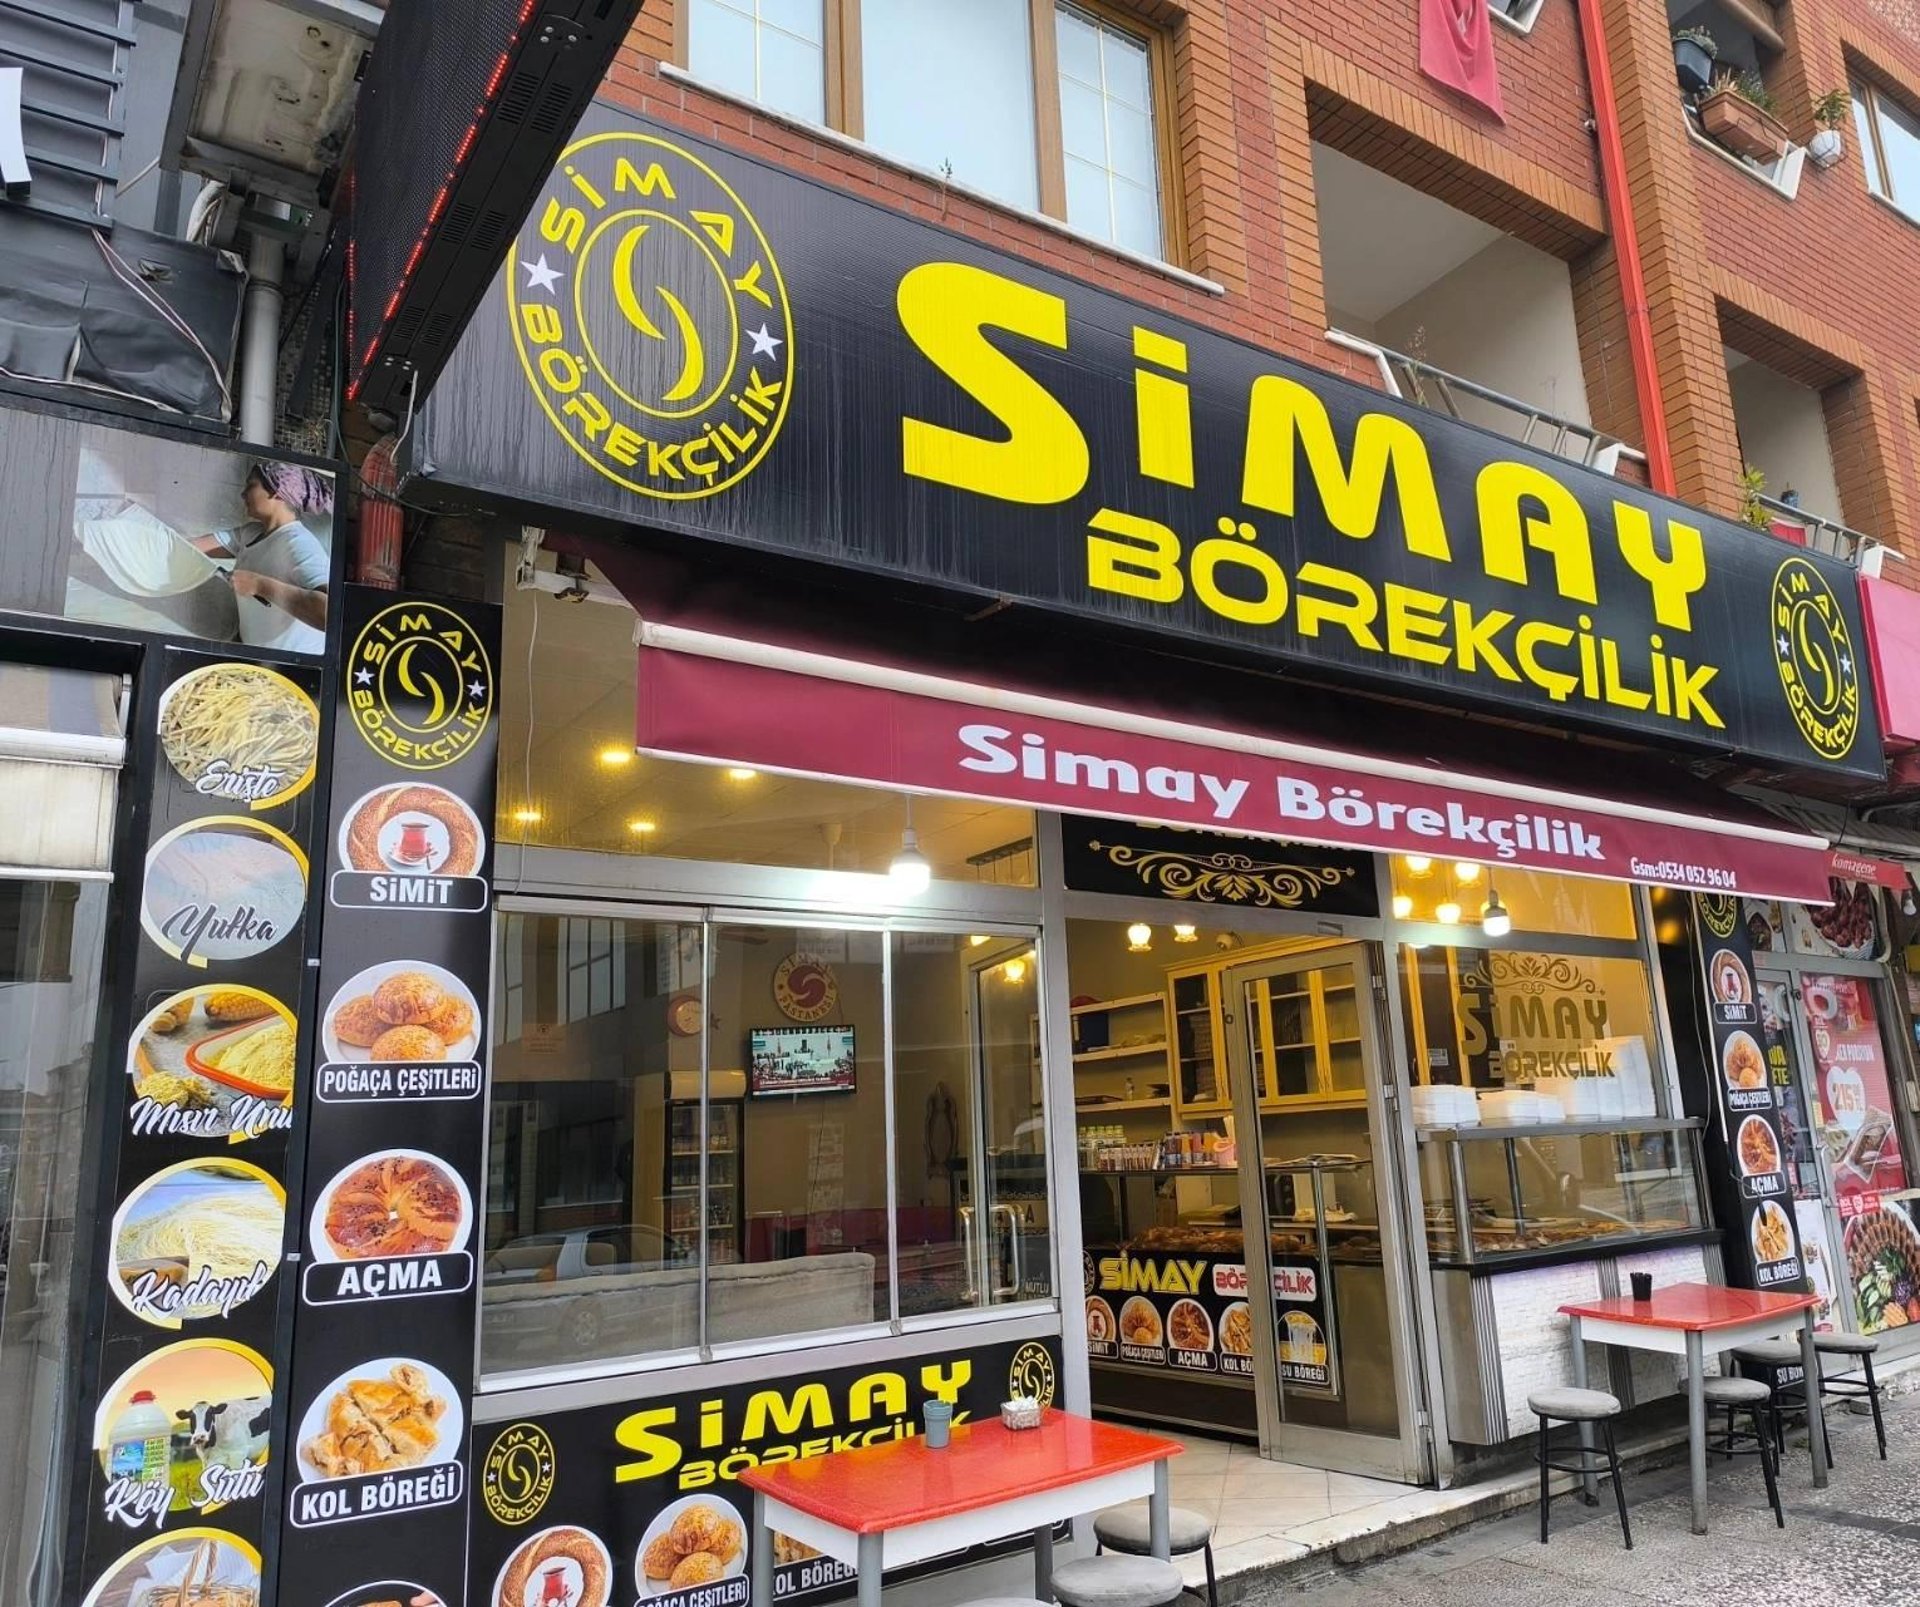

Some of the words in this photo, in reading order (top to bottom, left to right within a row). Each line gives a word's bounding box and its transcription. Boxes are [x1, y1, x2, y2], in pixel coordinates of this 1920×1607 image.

[541, 157, 772, 309] SİMAY
[521, 304, 782, 486] BÖREKÇİLİK
[897, 262, 1707, 632] SİMAY
[1087, 508, 1726, 728] BÖREKÇİLİK
[1778, 573, 1846, 644] SİMAY
[363, 613, 482, 673] SİMAY
[353, 690, 486, 760] BÖREKÇİLİK
[1781, 662, 1856, 749] BÖREKÇİLİK
[957, 724, 1251, 820] Simay
[1277, 775, 1606, 860] Börekçilik
[369, 877, 454, 905] SİMİT
[1686, 865, 1707, 884] 052
[161, 904, 277, 965] Yufka
[323, 1065, 392, 1097] POĞAÇA
[397, 1067, 476, 1097] ÇEŞİTLERİ
[130, 1095, 219, 1136] Mısır
[1750, 1175, 1779, 1197] AÇMA
[132, 1260, 268, 1320] Kadayıf
[338, 1261, 443, 1299] AÇMA
[1099, 1250, 1208, 1296] SİMAY
[1177, 1351, 1209, 1368] AÇMA
[1223, 1357, 1238, 1371] KOL
[615, 1359, 973, 1484] SİMAY
[104, 1477, 176, 1530] Köy
[301, 1488, 352, 1521] KOL
[360, 1466, 455, 1512] BÖREĞİ
[486, 1476, 552, 1519] BÖREKÇİLİK
[773, 1571, 796, 1595] OL
